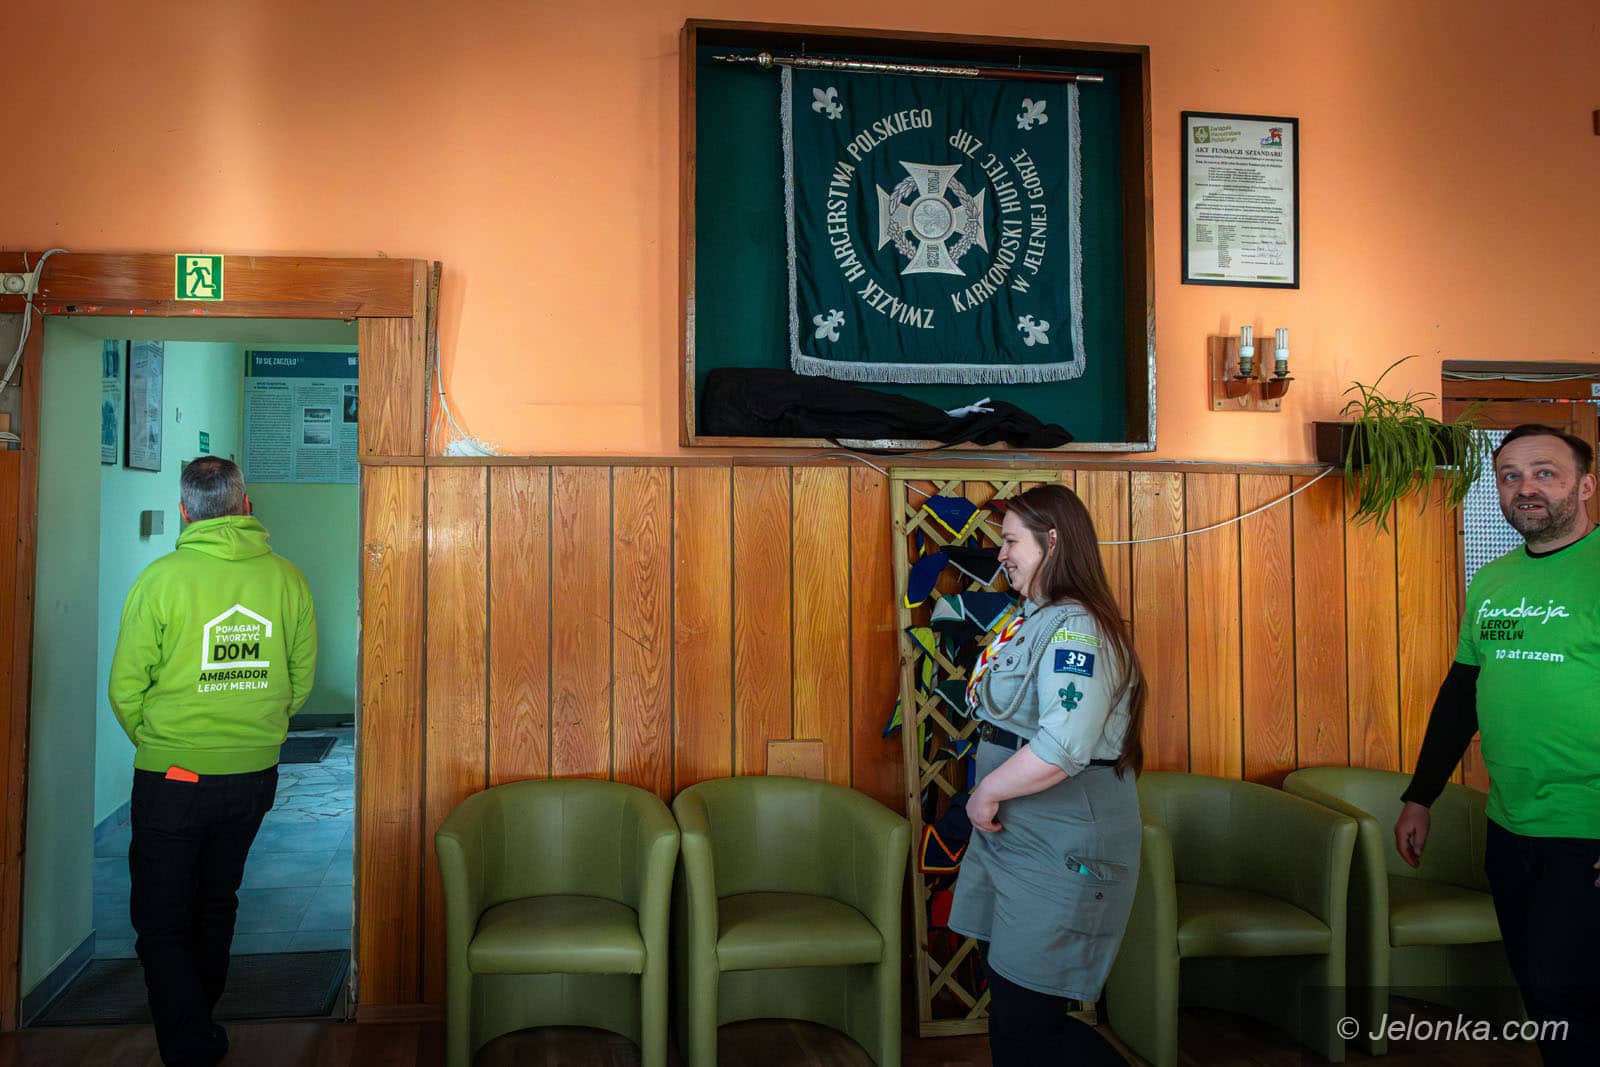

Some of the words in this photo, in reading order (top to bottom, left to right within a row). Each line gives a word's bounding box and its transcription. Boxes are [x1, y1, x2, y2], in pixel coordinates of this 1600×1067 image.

[846, 108, 932, 161] POLSKIEGO
[949, 129, 983, 159] ZHP
[1195, 146, 1209, 154] AKT
[980, 153, 1021, 213] HUFIEC
[1010, 148, 1044, 199] GÓRZE
[827, 161, 866, 282] HARCERSTWA
[1023, 204, 1047, 275] JELENIEJ
[951, 220, 1022, 312] KARKONOSKI
[1011, 274, 1030, 293] W
[255, 357, 263, 365] TU
[1476, 597, 1570, 624] fundacja
[1480, 619, 1519, 630] LEROY
[1480, 630, 1524, 641] MERLIN
[213, 642, 260, 661] DOM
[1065, 651, 1087, 667] 39
[1495, 649, 1506, 660] 10
[1507, 649, 1521, 660] at
[1522, 651, 1565, 663] razem
[199, 669, 268, 682] AMBASADOR
[197, 682, 229, 693] LEROY
[230, 681, 268, 690] MERLIN
